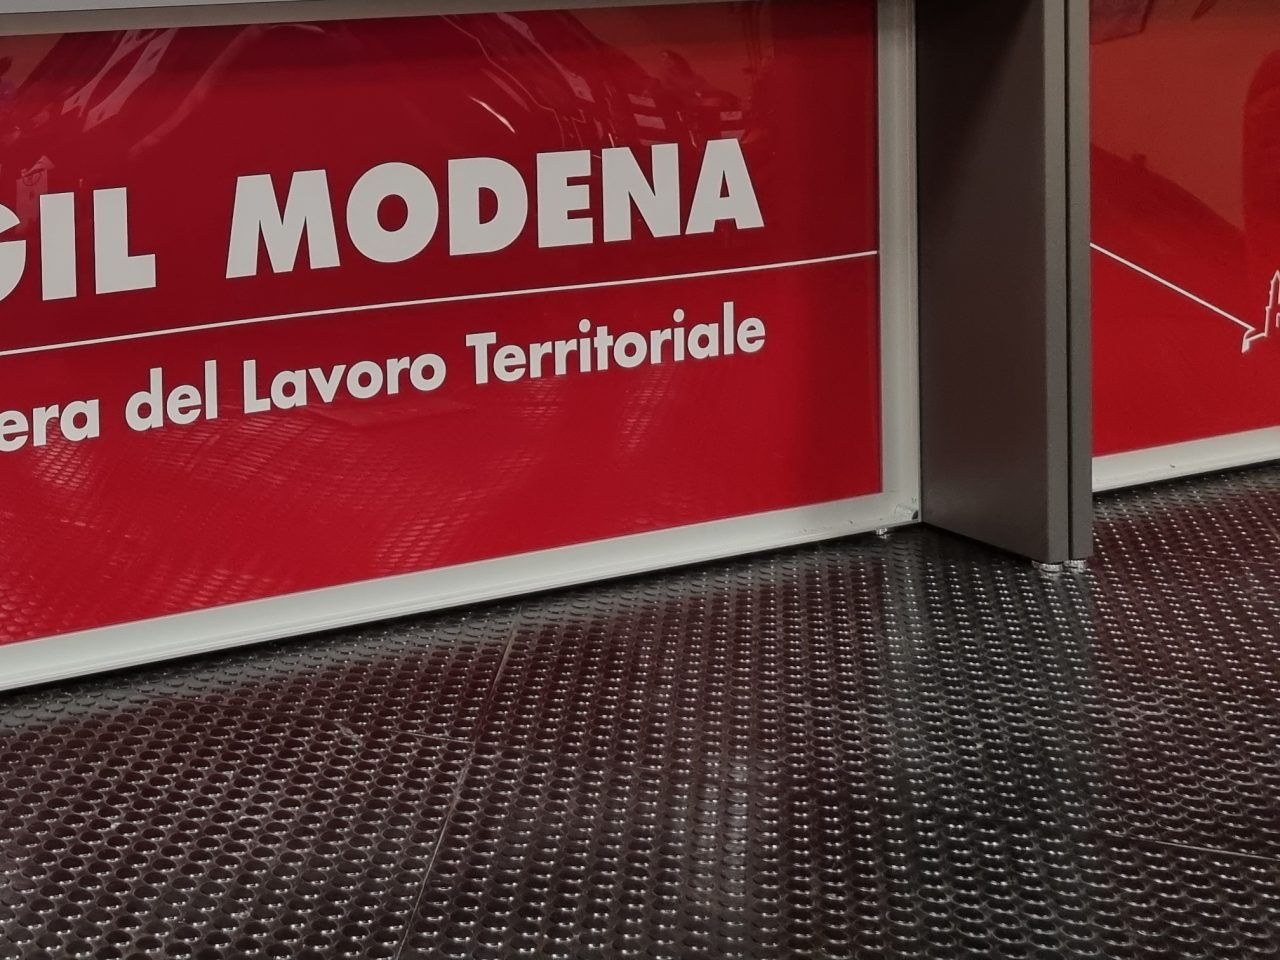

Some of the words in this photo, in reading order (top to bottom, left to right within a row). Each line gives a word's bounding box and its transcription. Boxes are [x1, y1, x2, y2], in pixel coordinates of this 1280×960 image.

[225, 138, 765, 279] MODENA
[125, 360, 218, 432] del
[243, 352, 447, 414] Lavoro
[465, 301, 766, 385] Territoriale
